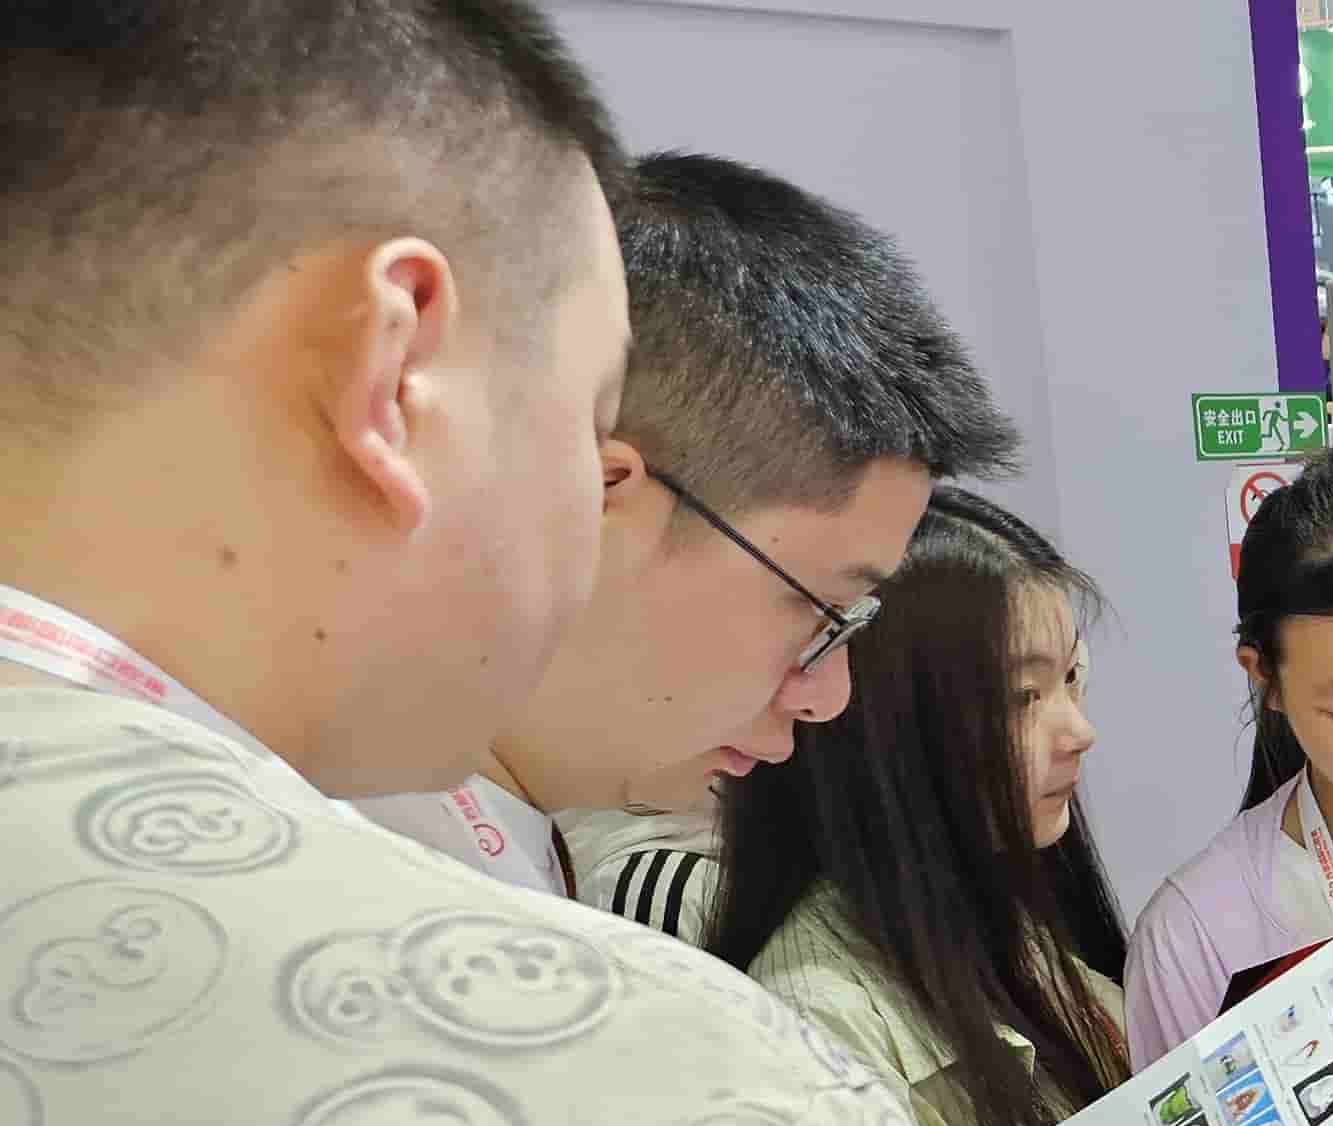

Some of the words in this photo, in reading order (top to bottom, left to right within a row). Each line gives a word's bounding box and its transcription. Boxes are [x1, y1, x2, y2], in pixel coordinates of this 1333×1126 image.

[1203, 407, 1257, 427] 安全出口
[1216, 429, 1245, 446] EXIT
